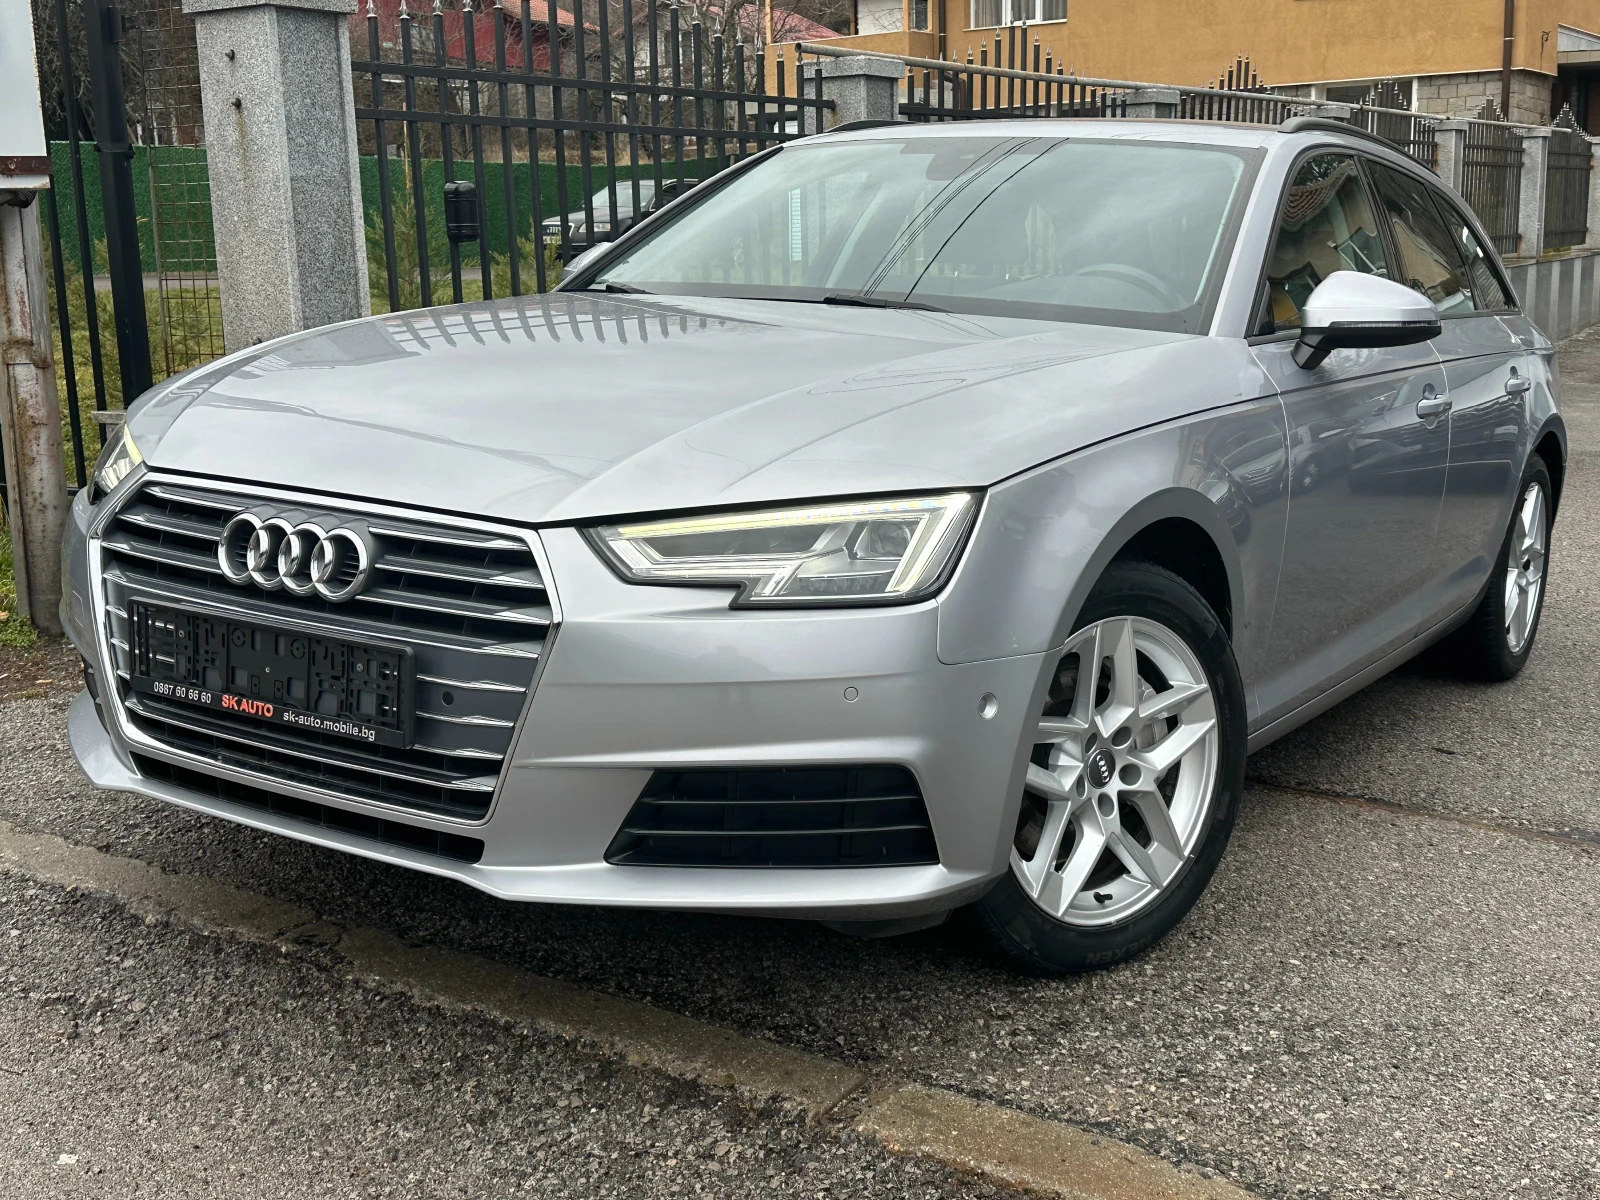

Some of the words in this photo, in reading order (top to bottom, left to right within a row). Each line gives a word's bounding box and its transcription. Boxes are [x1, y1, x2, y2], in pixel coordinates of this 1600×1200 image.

[153, 681, 174, 696] 0887
[175, 685, 187, 698] 60
[188, 688, 200, 701] 66
[200, 690, 213, 704] 60
[221, 694, 238, 711] SK
[239, 699, 275, 718] AUTO
[282, 711, 376, 742] sk-auto.mobile.bg
